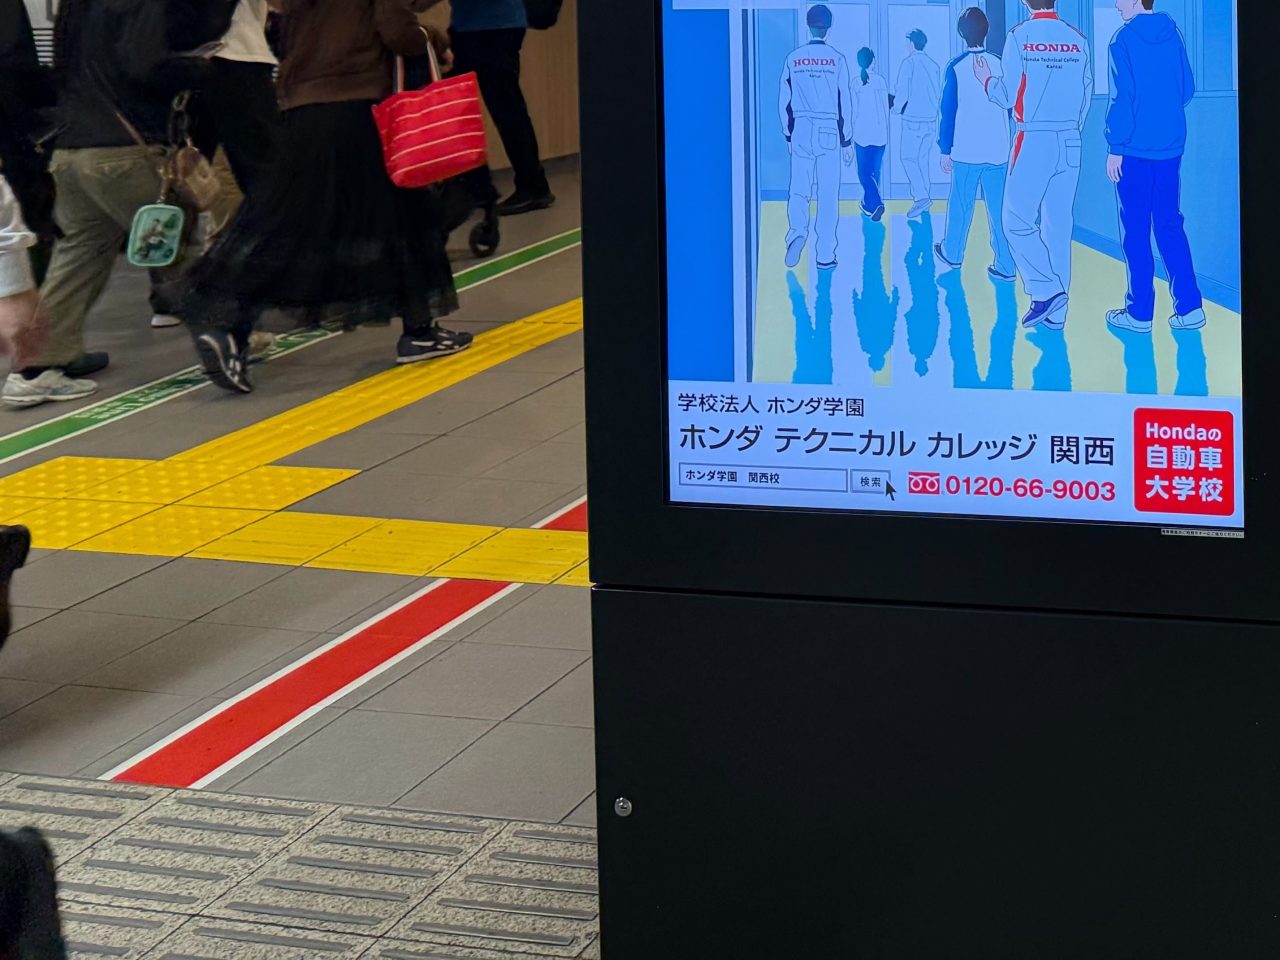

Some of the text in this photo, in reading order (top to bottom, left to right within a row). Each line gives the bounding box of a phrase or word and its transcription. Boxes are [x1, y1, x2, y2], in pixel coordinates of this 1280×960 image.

[1023, 43, 1081, 53] HONDA
[793, 58, 836, 67] HONDA
[677, 393, 865, 418] 学校法人 ホンダ学園
[1145, 422, 1222, 442] Hondaの
[679, 424, 1115, 466] ホンダ テクニカル カレッジ 関西
[1146, 444, 1223, 471] 自動車
[685, 470, 780, 485] ホンダ学園 関西校
[860, 476, 882, 488] 検索
[945, 475, 1116, 501] 0120-66-9003
[1145, 475, 1223, 502] 大学校
